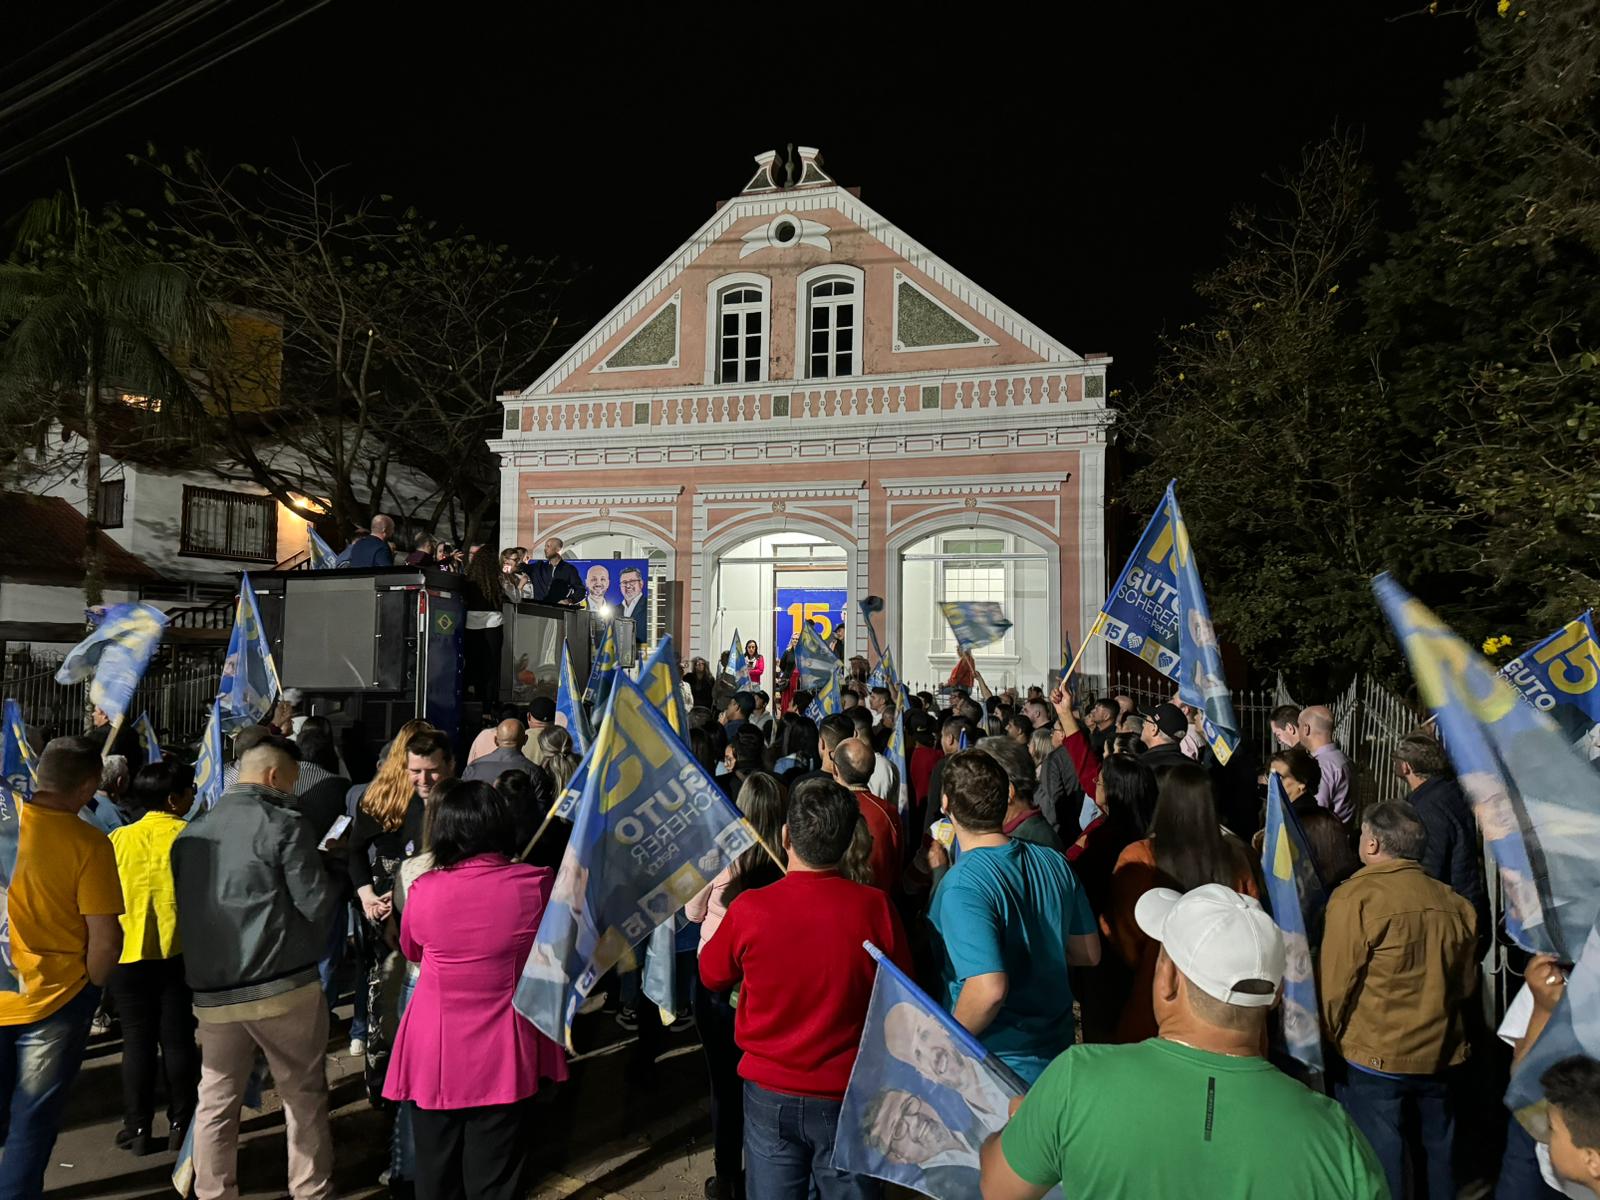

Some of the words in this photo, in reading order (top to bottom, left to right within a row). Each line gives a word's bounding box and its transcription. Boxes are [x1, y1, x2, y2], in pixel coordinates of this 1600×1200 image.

[787, 603, 832, 641] 15
[1117, 585, 1180, 631] SCHERER
[1104, 622, 1122, 640] 15
[1152, 619, 1174, 640] Petry
[1533, 621, 1600, 694] 15
[1504, 658, 1556, 712] GUTO
